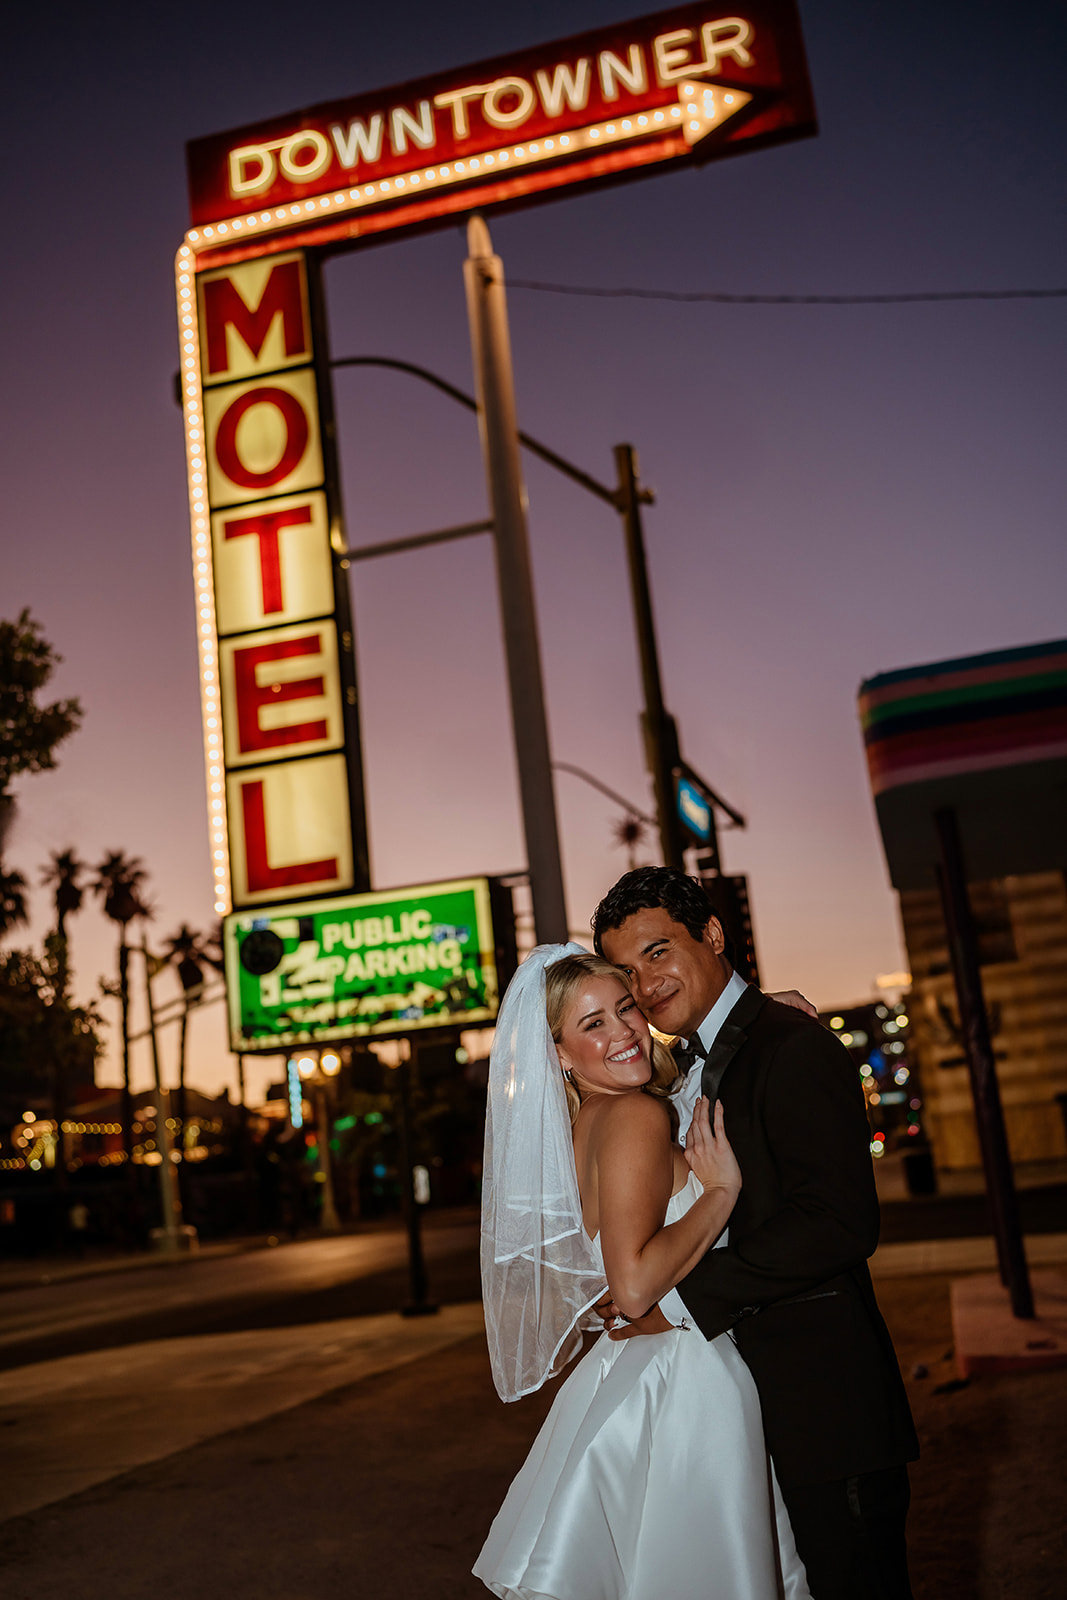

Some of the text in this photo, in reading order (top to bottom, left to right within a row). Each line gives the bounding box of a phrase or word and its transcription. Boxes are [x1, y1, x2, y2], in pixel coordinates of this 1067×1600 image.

[228, 16, 754, 197] DOWNTOWNER
[203, 260, 338, 893] MOTEL
[322, 909, 432, 953] PUBLIC
[326, 939, 462, 983] PARKING
